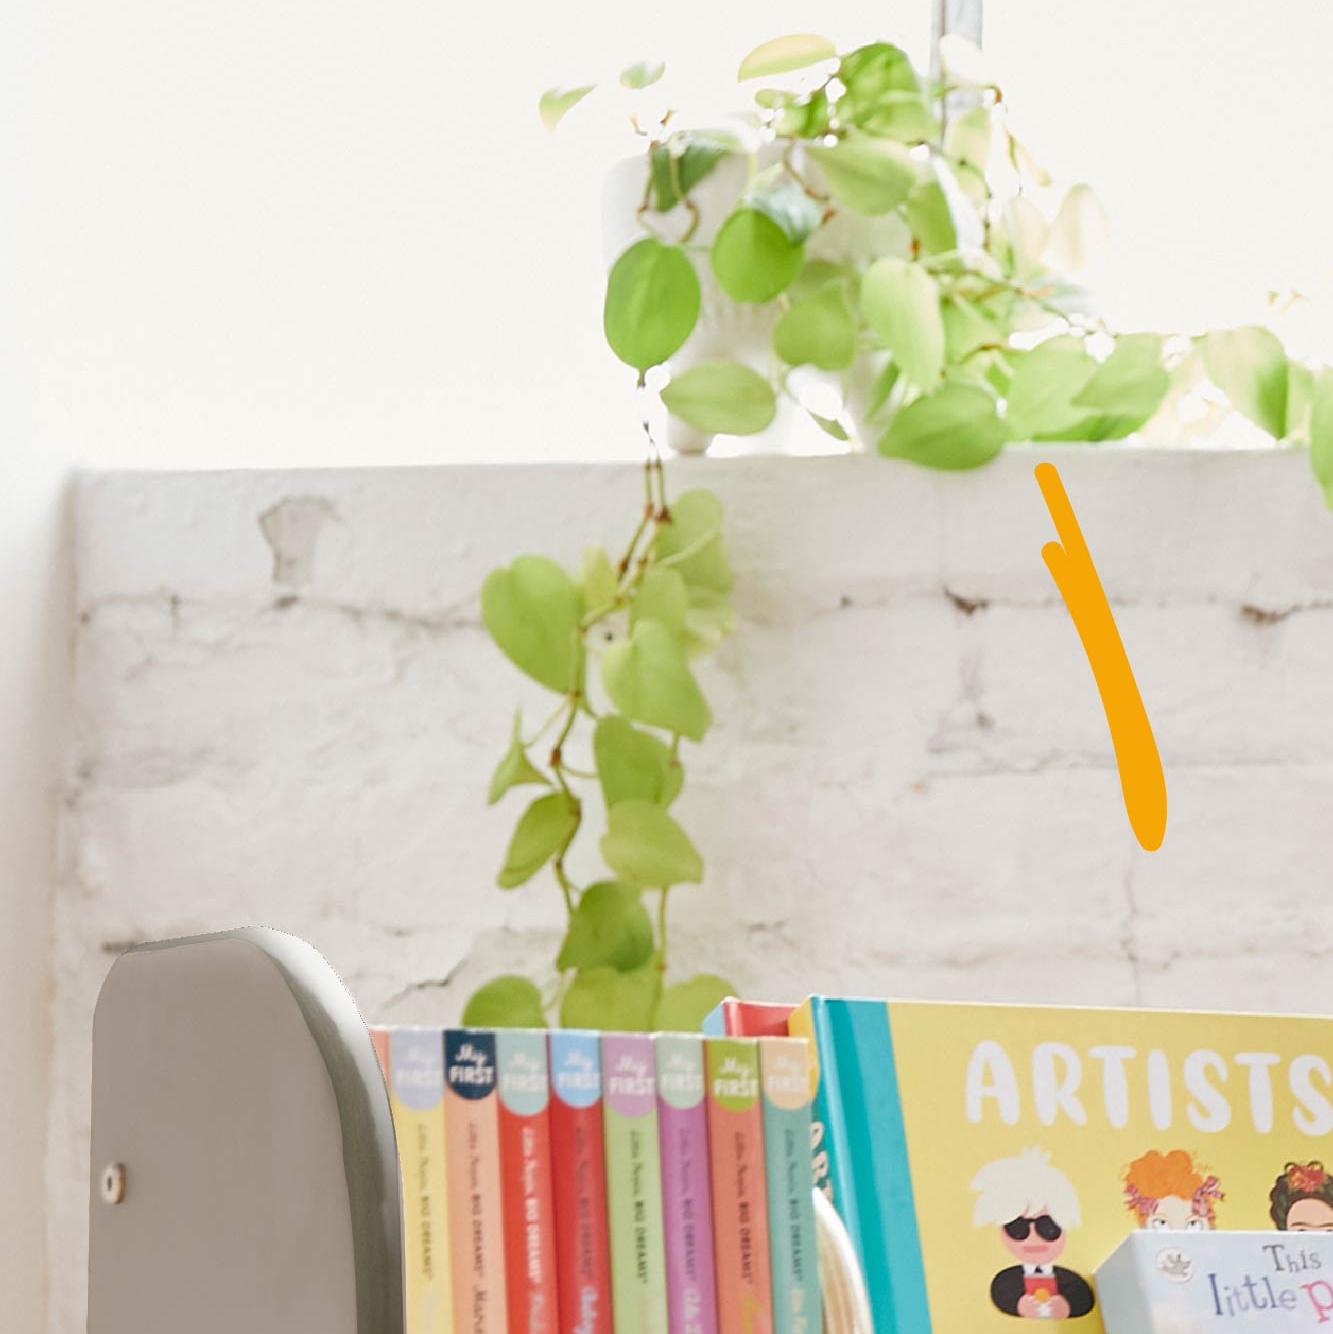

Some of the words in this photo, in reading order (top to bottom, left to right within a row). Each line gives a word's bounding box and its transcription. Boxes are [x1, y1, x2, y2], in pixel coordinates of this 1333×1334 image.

[456, 1044, 487, 1067] My
[450, 1066, 494, 1084] FIRST
[617, 1055, 647, 1078] My
[720, 1057, 750, 1079] My
[503, 1074, 548, 1092] FIRST
[557, 1072, 599, 1089] FIRST
[609, 1078, 654, 1095] FIRST
[713, 1078, 758, 1097] FIRST
[767, 1075, 808, 1092] FIRST
[1262, 1244, 1322, 1273] This
[1209, 1276, 1298, 1317] little
